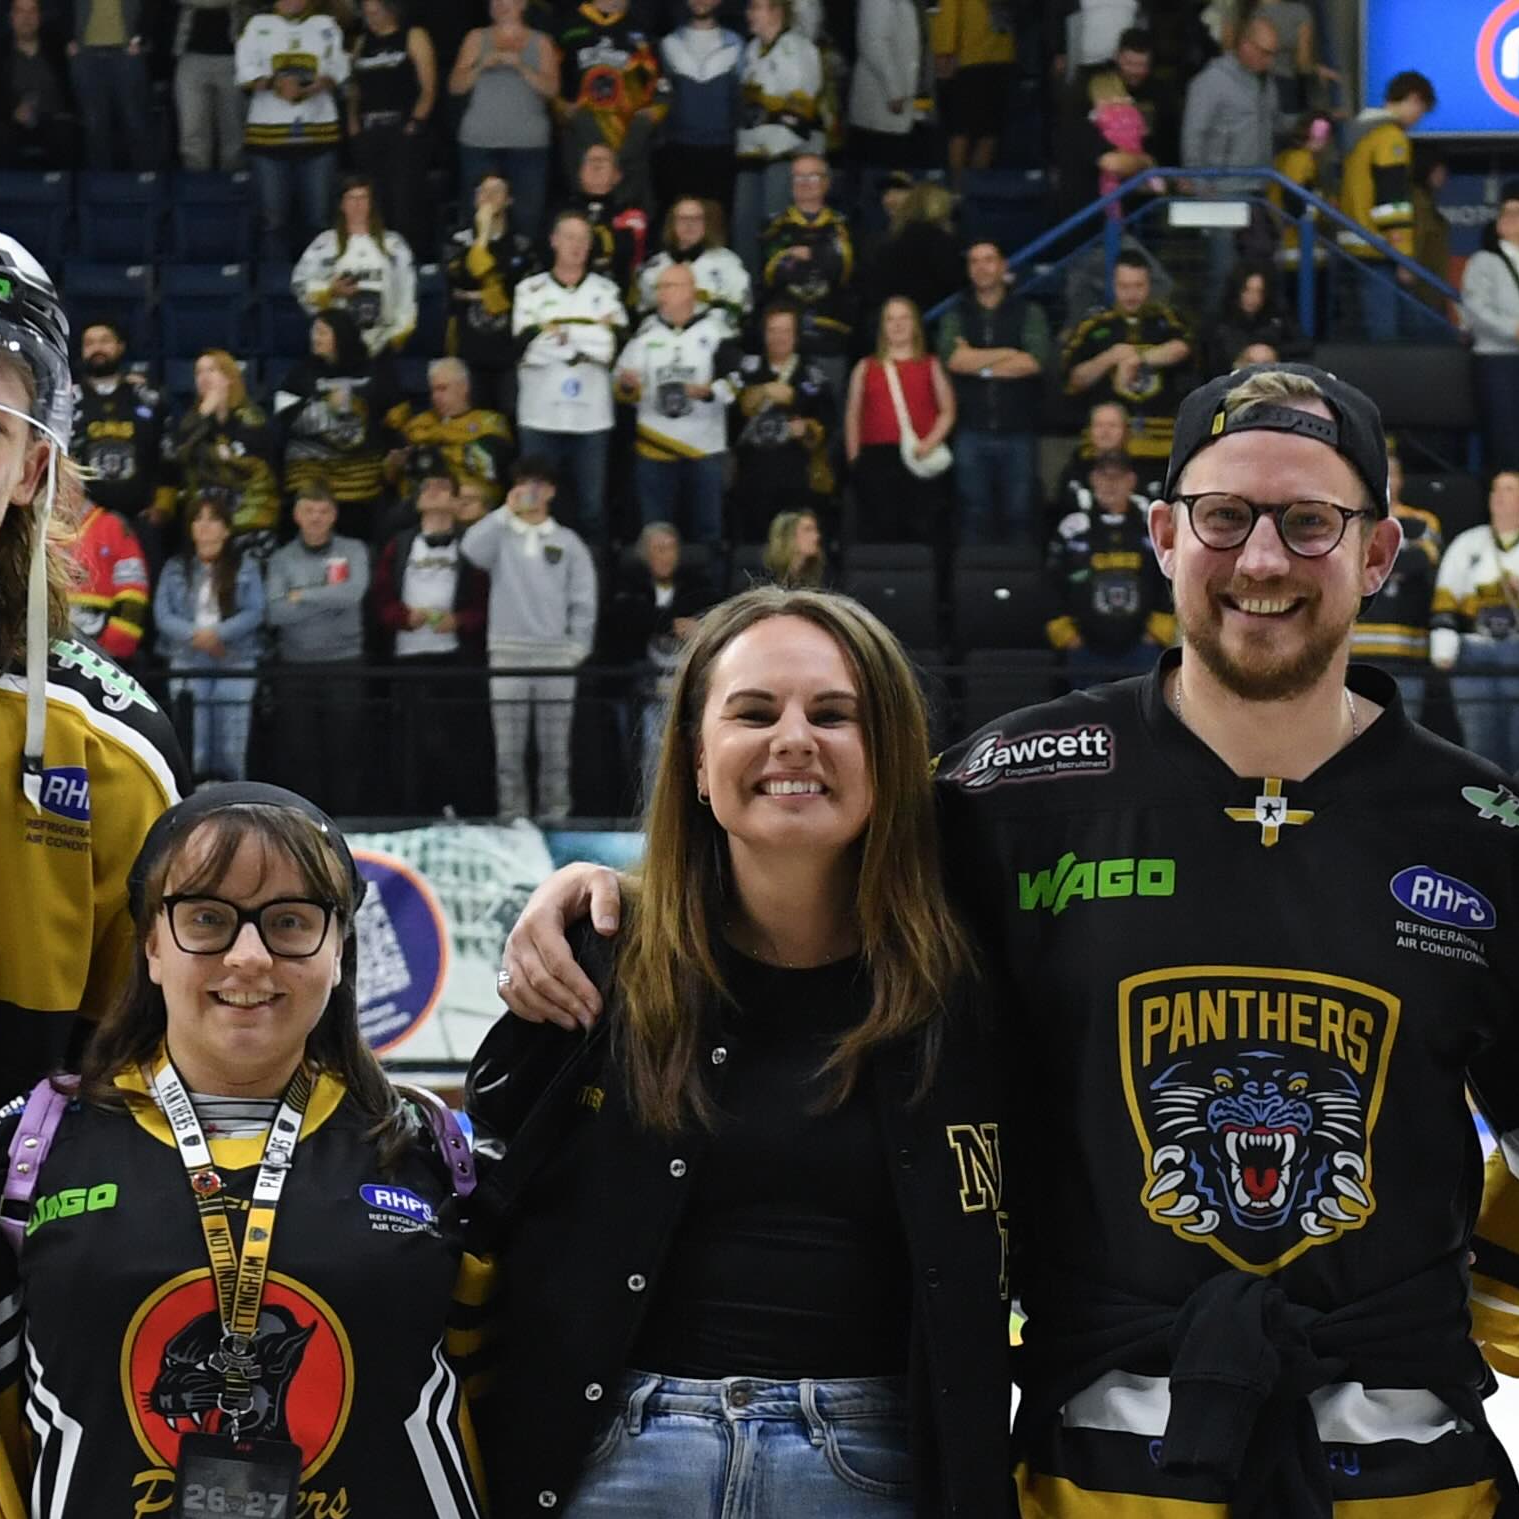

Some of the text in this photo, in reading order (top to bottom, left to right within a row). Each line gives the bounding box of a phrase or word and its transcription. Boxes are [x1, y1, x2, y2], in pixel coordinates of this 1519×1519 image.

[1017, 851, 1177, 917] WAGO
[1396, 935, 1418, 950] AIR
[1141, 988, 1375, 1076] PANTHERS
[161, 1080, 196, 1132] PANTHERS
[374, 1188, 434, 1223] RHPS
[233, 1255, 264, 1338] TTINGHAM
